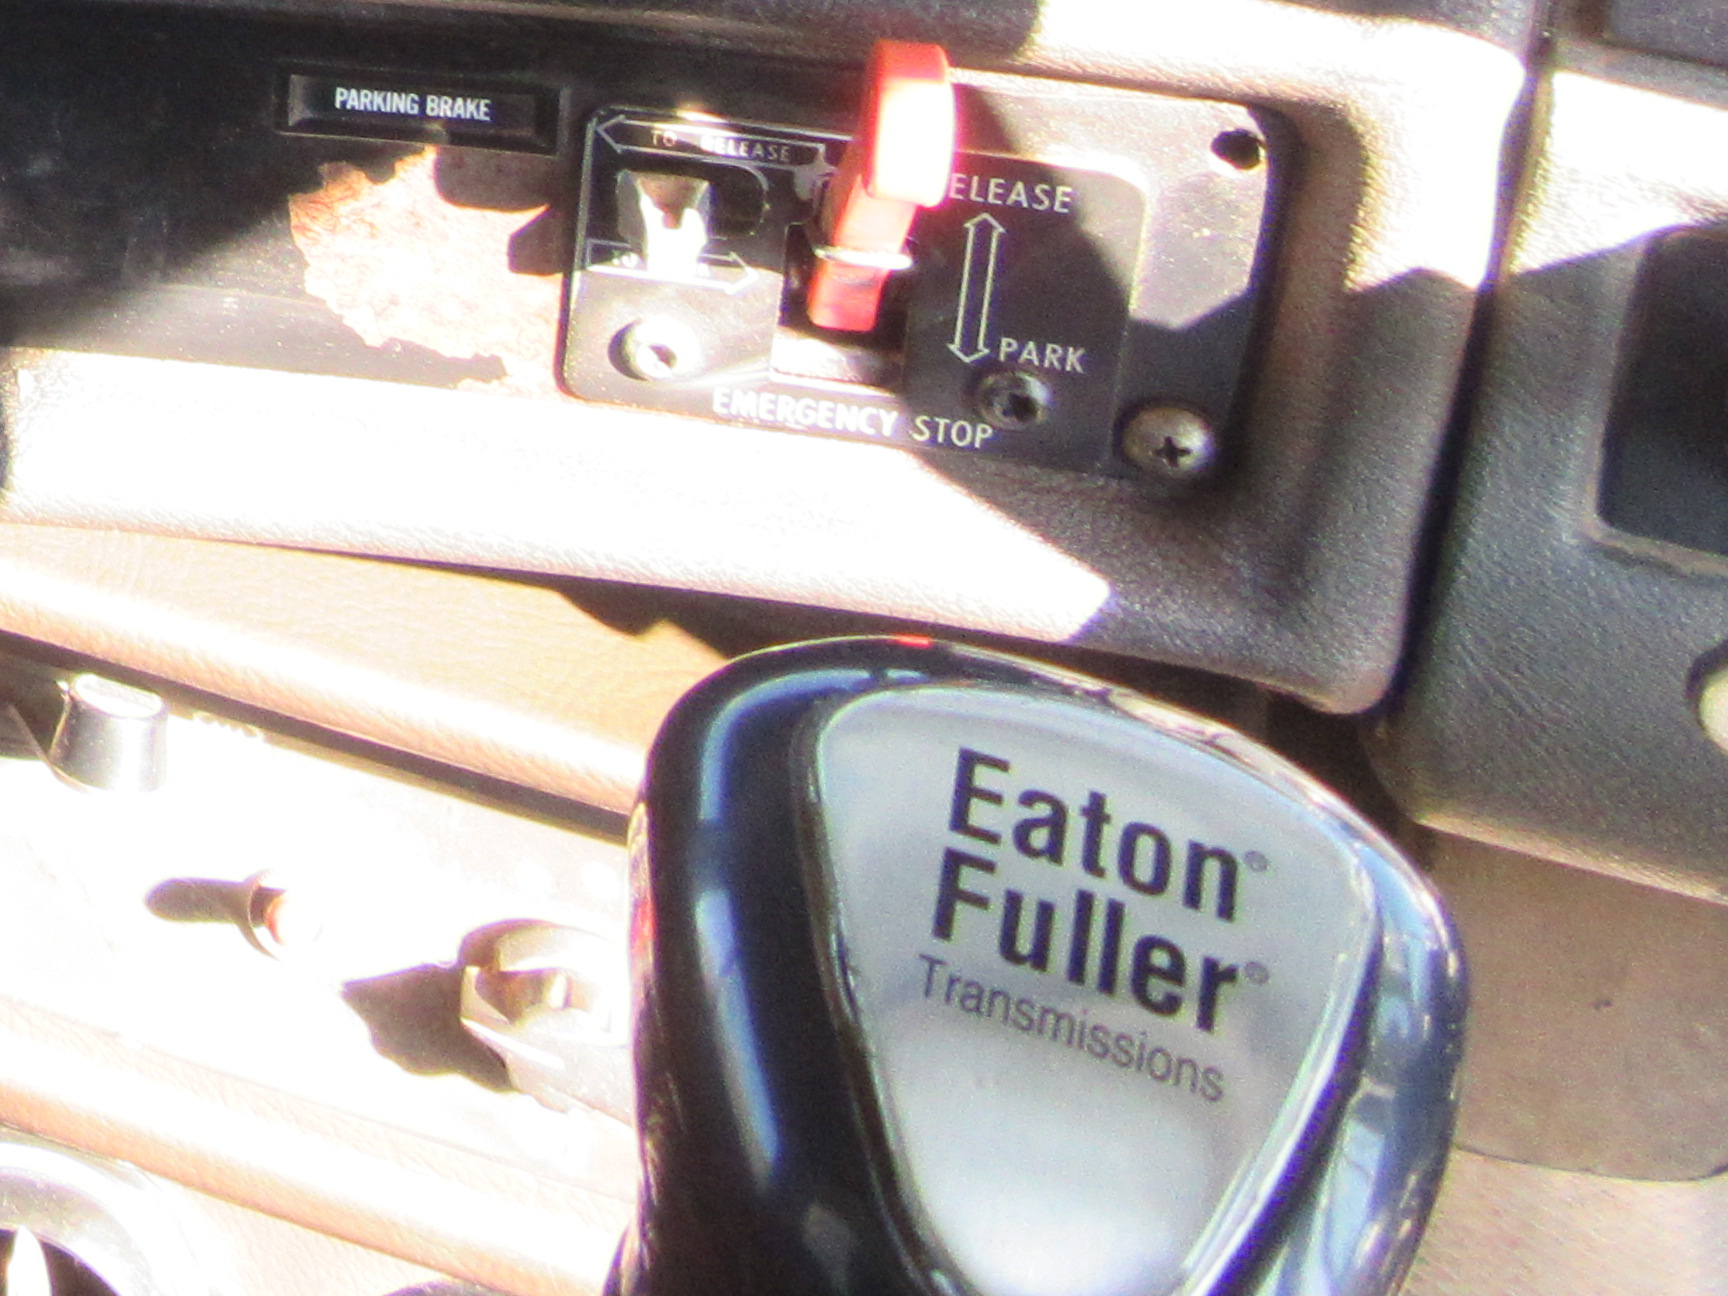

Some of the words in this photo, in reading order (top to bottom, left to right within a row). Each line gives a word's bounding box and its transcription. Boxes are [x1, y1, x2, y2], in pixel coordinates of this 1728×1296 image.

[335, 86, 418, 114] PARKING
[425, 94, 491, 122] BRAKE
[651, 129, 677, 147] TO
[699, 134, 790, 163] RELEASE
[949, 172, 1073, 214] ELEASE
[999, 337, 1086, 374] PARK
[713, 387, 901, 437] EMERGENCY
[911, 415, 994, 448] STOP
[947, 745, 1239, 922] Eaton
[931, 845, 1241, 1036] Fuller
[918, 952, 1227, 1105] Transmissions
